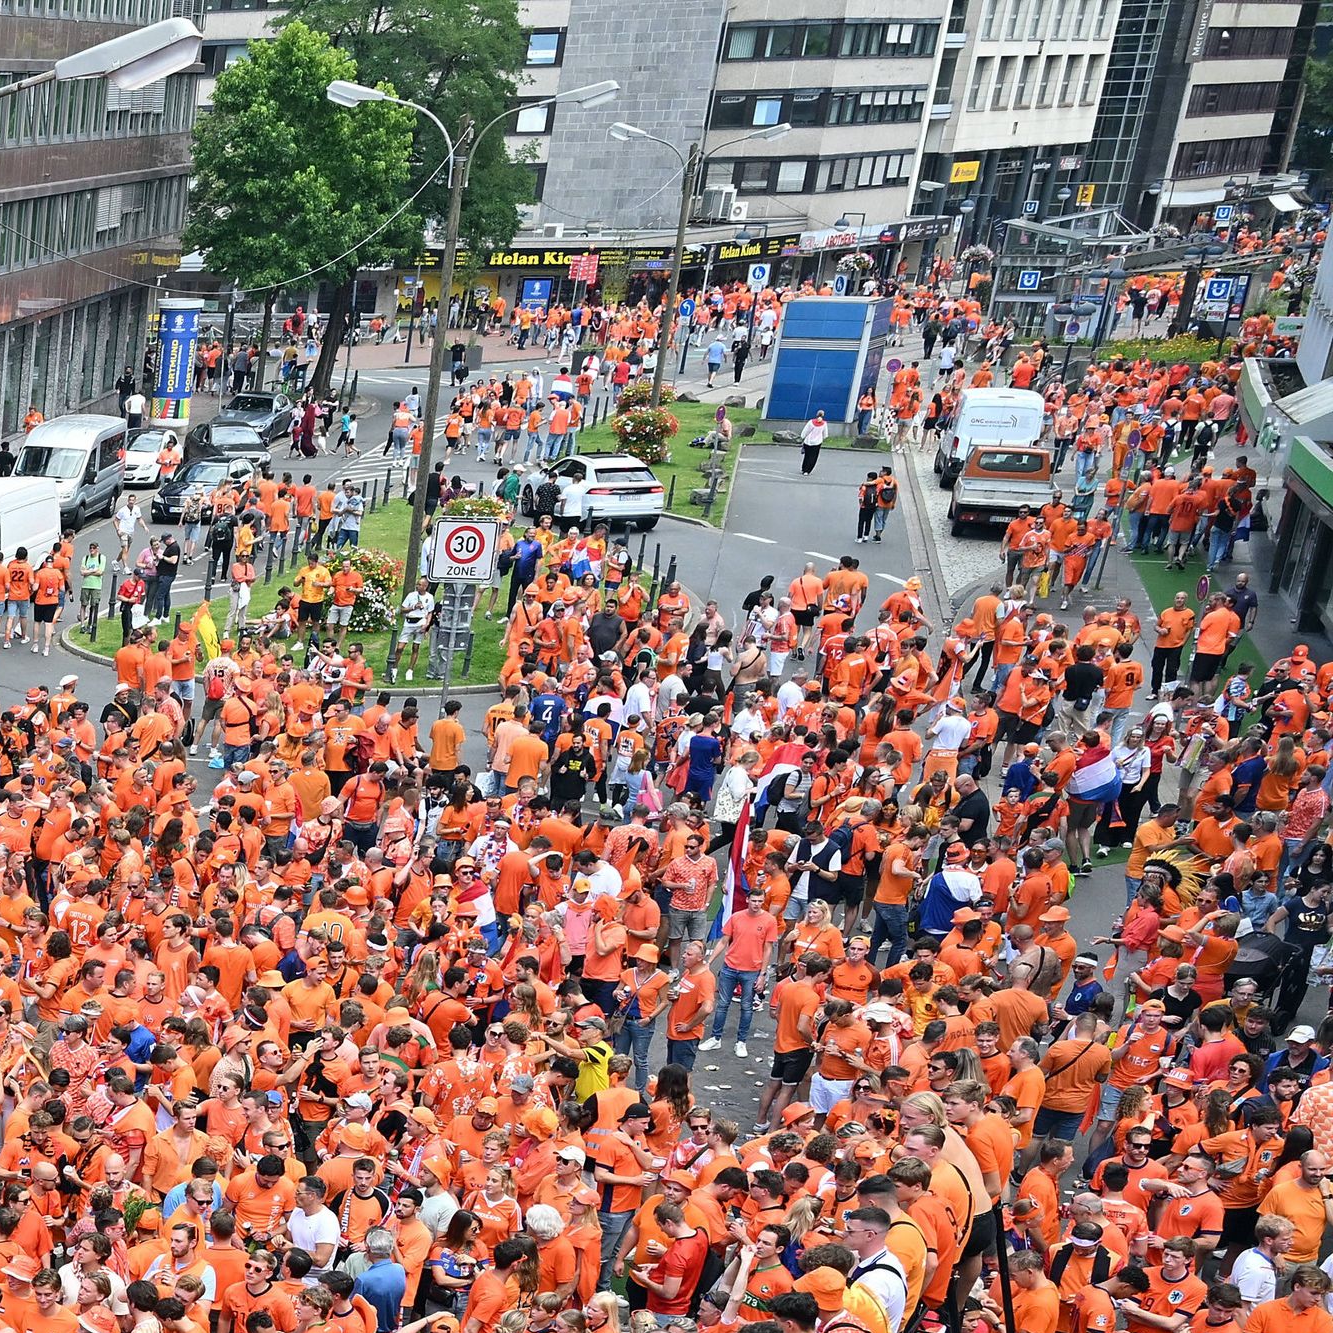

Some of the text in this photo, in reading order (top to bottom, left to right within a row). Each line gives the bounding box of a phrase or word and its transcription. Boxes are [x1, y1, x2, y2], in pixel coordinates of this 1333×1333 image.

[1192, 12, 1210, 56] Mercure
[489, 252, 539, 266] Helan
[719, 242, 761, 260] Helan Kiosk
[167, 339, 178, 393] DORTMUND
[453, 536, 478, 553] 30
[11, 571, 25, 582] 22
[446, 566, 477, 576] ZONE
[1125, 672, 1135, 686] 9
[541, 706, 554, 723] 4
[71, 920, 90, 944] 12
[322, 922, 344, 943] 10
